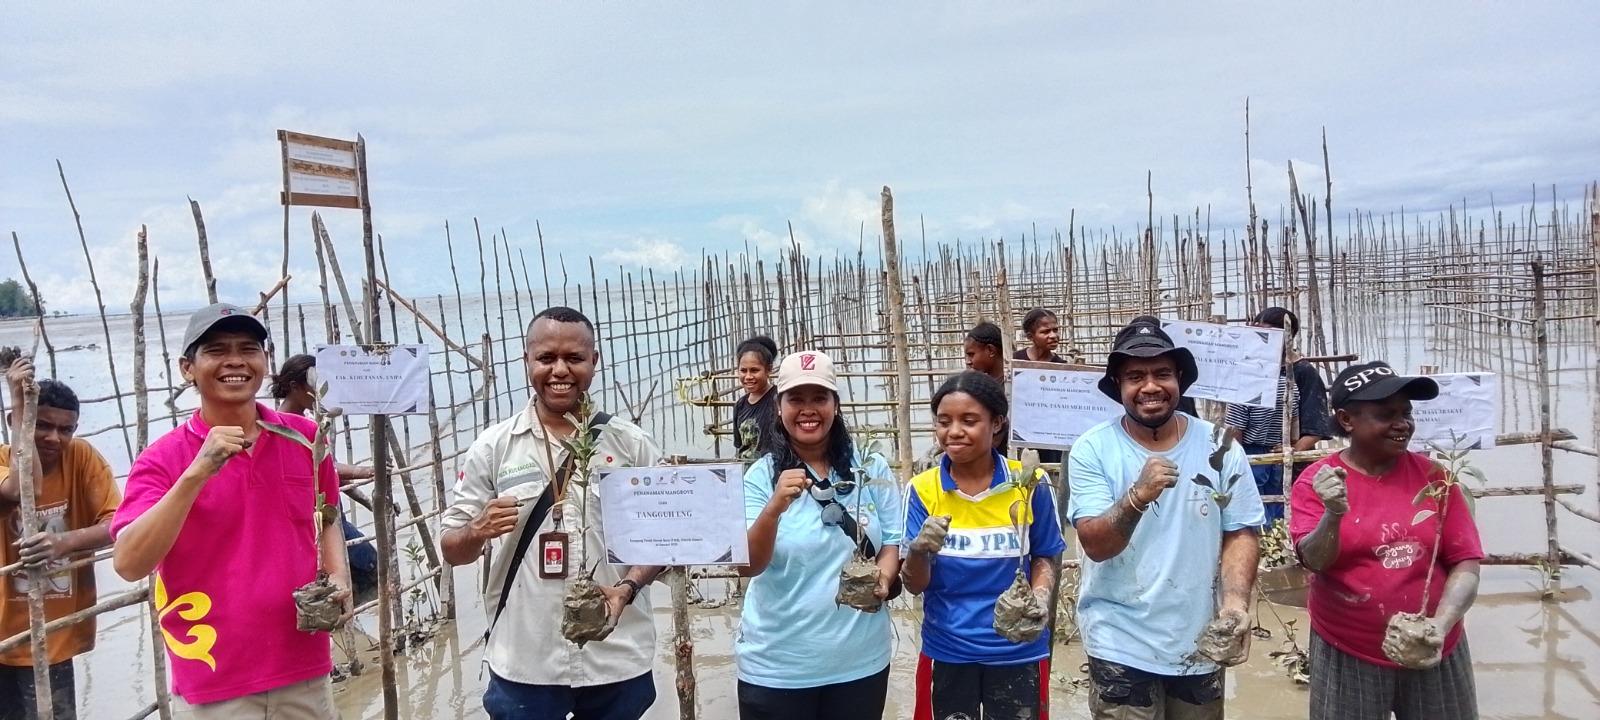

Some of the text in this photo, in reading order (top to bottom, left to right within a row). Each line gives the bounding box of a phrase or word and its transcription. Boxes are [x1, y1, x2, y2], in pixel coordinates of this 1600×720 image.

[1344, 366, 1396, 392] SPO
[636, 510, 693, 519] TANGGUH LNG
[944, 532, 1020, 551] MP YPK
